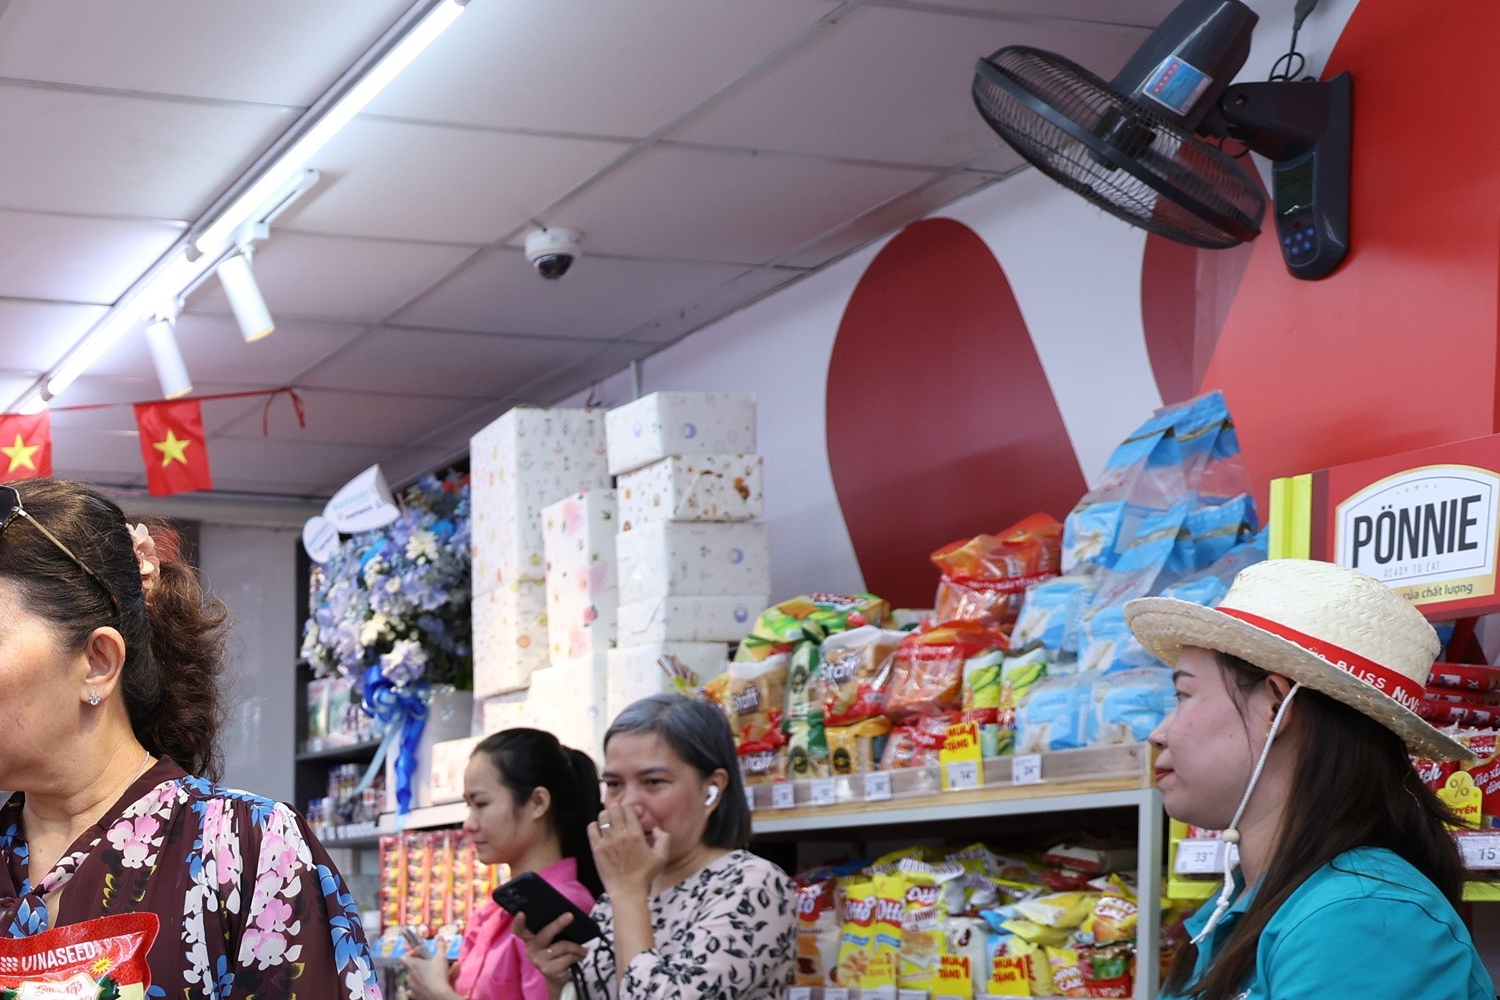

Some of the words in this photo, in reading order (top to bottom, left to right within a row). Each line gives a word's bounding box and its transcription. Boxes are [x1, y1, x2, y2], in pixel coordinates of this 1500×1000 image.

[1352, 494, 1482, 569] PÖNNIE
[1384, 565, 1408, 578] READY
[1413, 563, 1422, 574] TO
[1426, 560, 1440, 572] EAT
[1421, 584, 1442, 598] chất
[1444, 582, 1473, 596] lượng
[1337, 660, 1386, 689] BLISS
[1480, 848, 1496, 861] 15
[21, 942, 96, 971] VINASEED
